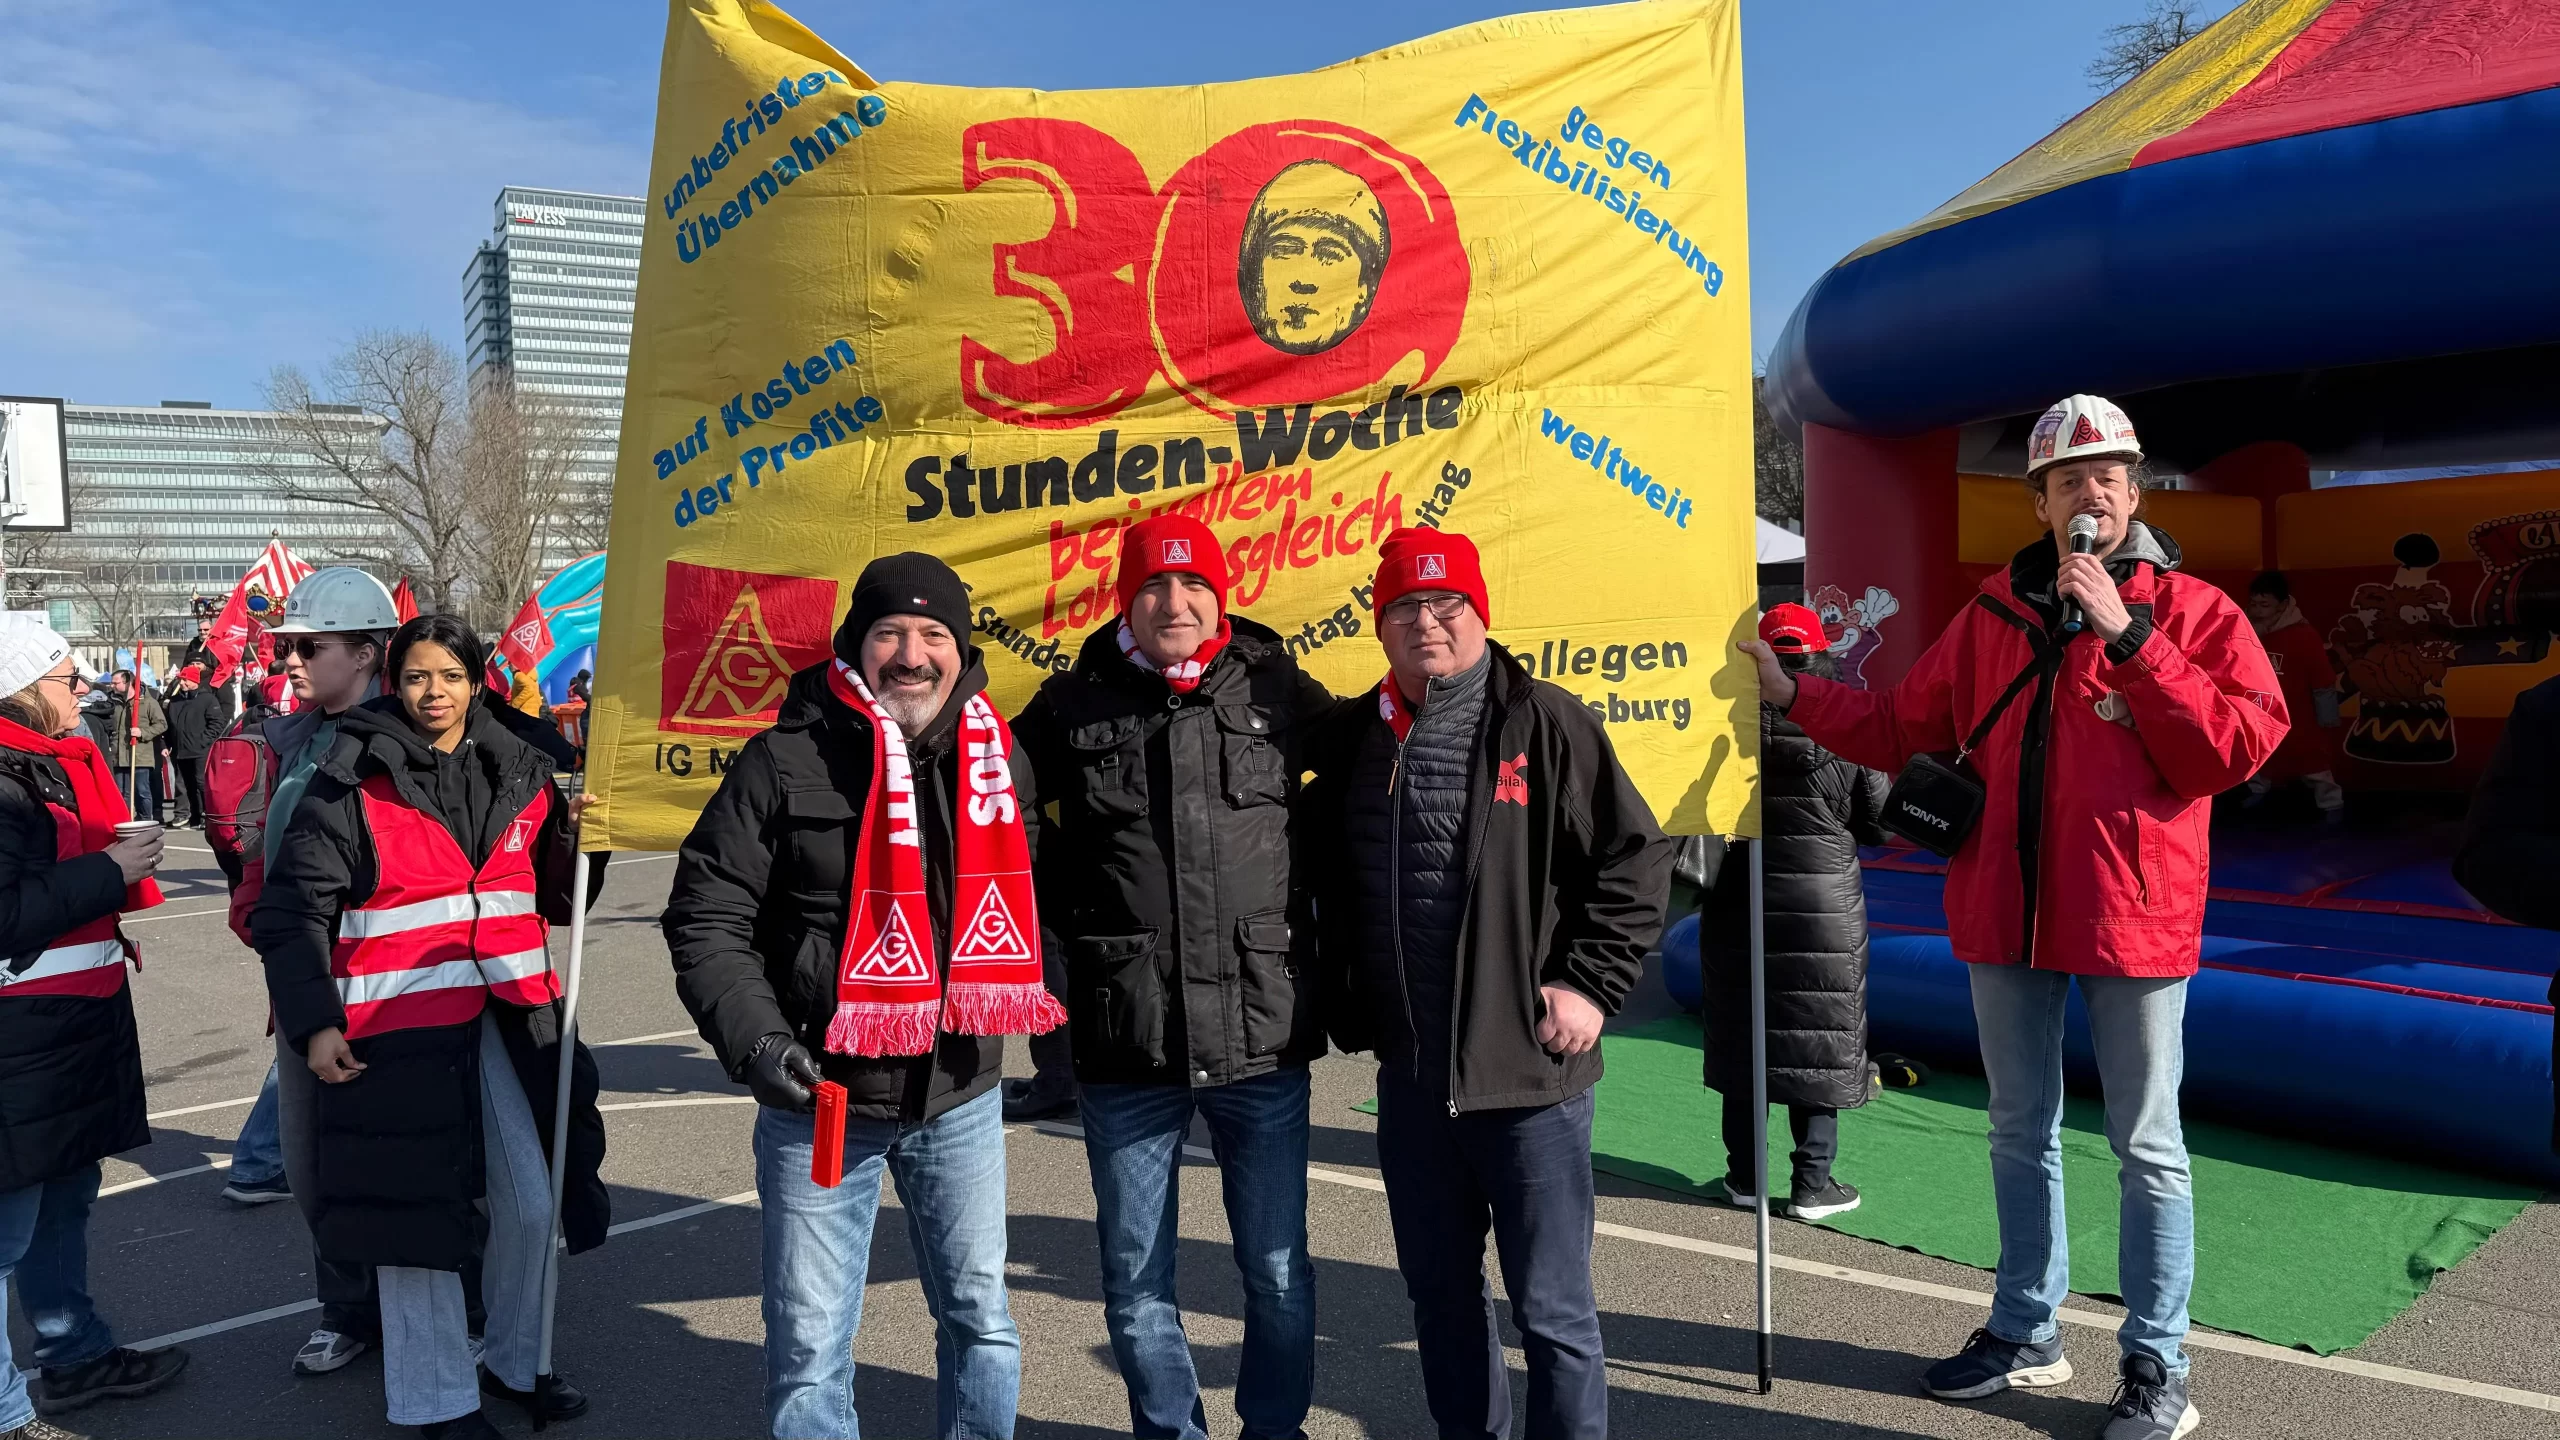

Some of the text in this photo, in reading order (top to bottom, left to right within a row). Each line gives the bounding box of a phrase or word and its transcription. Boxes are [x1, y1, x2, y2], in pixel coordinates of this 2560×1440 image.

[663, 70, 847, 220] unbefriste
[675, 94, 887, 264] Übernahme
[1454, 92, 1724, 298] Flexibilisierung
[1560, 105, 1672, 190] gegen
[514, 205, 567, 226] LANXESS
[961, 116, 1472, 428] 30
[653, 338, 857, 481] auf Kosten
[674, 395, 883, 528] der Profite
[906, 384, 1464, 523] Stunden-Woche
[1540, 408, 1694, 529] weltweit
[1151, 459, 1312, 527] ollem
[1284, 603, 1362, 659] ntag
[1415, 460, 1472, 529] itag
[971, 606, 1080, 673] Stunde
[1502, 639, 1688, 682] ollegen
[655, 743, 693, 777] IG
[1577, 692, 1691, 730] sburg
[1902, 800, 1951, 831] VONYX
